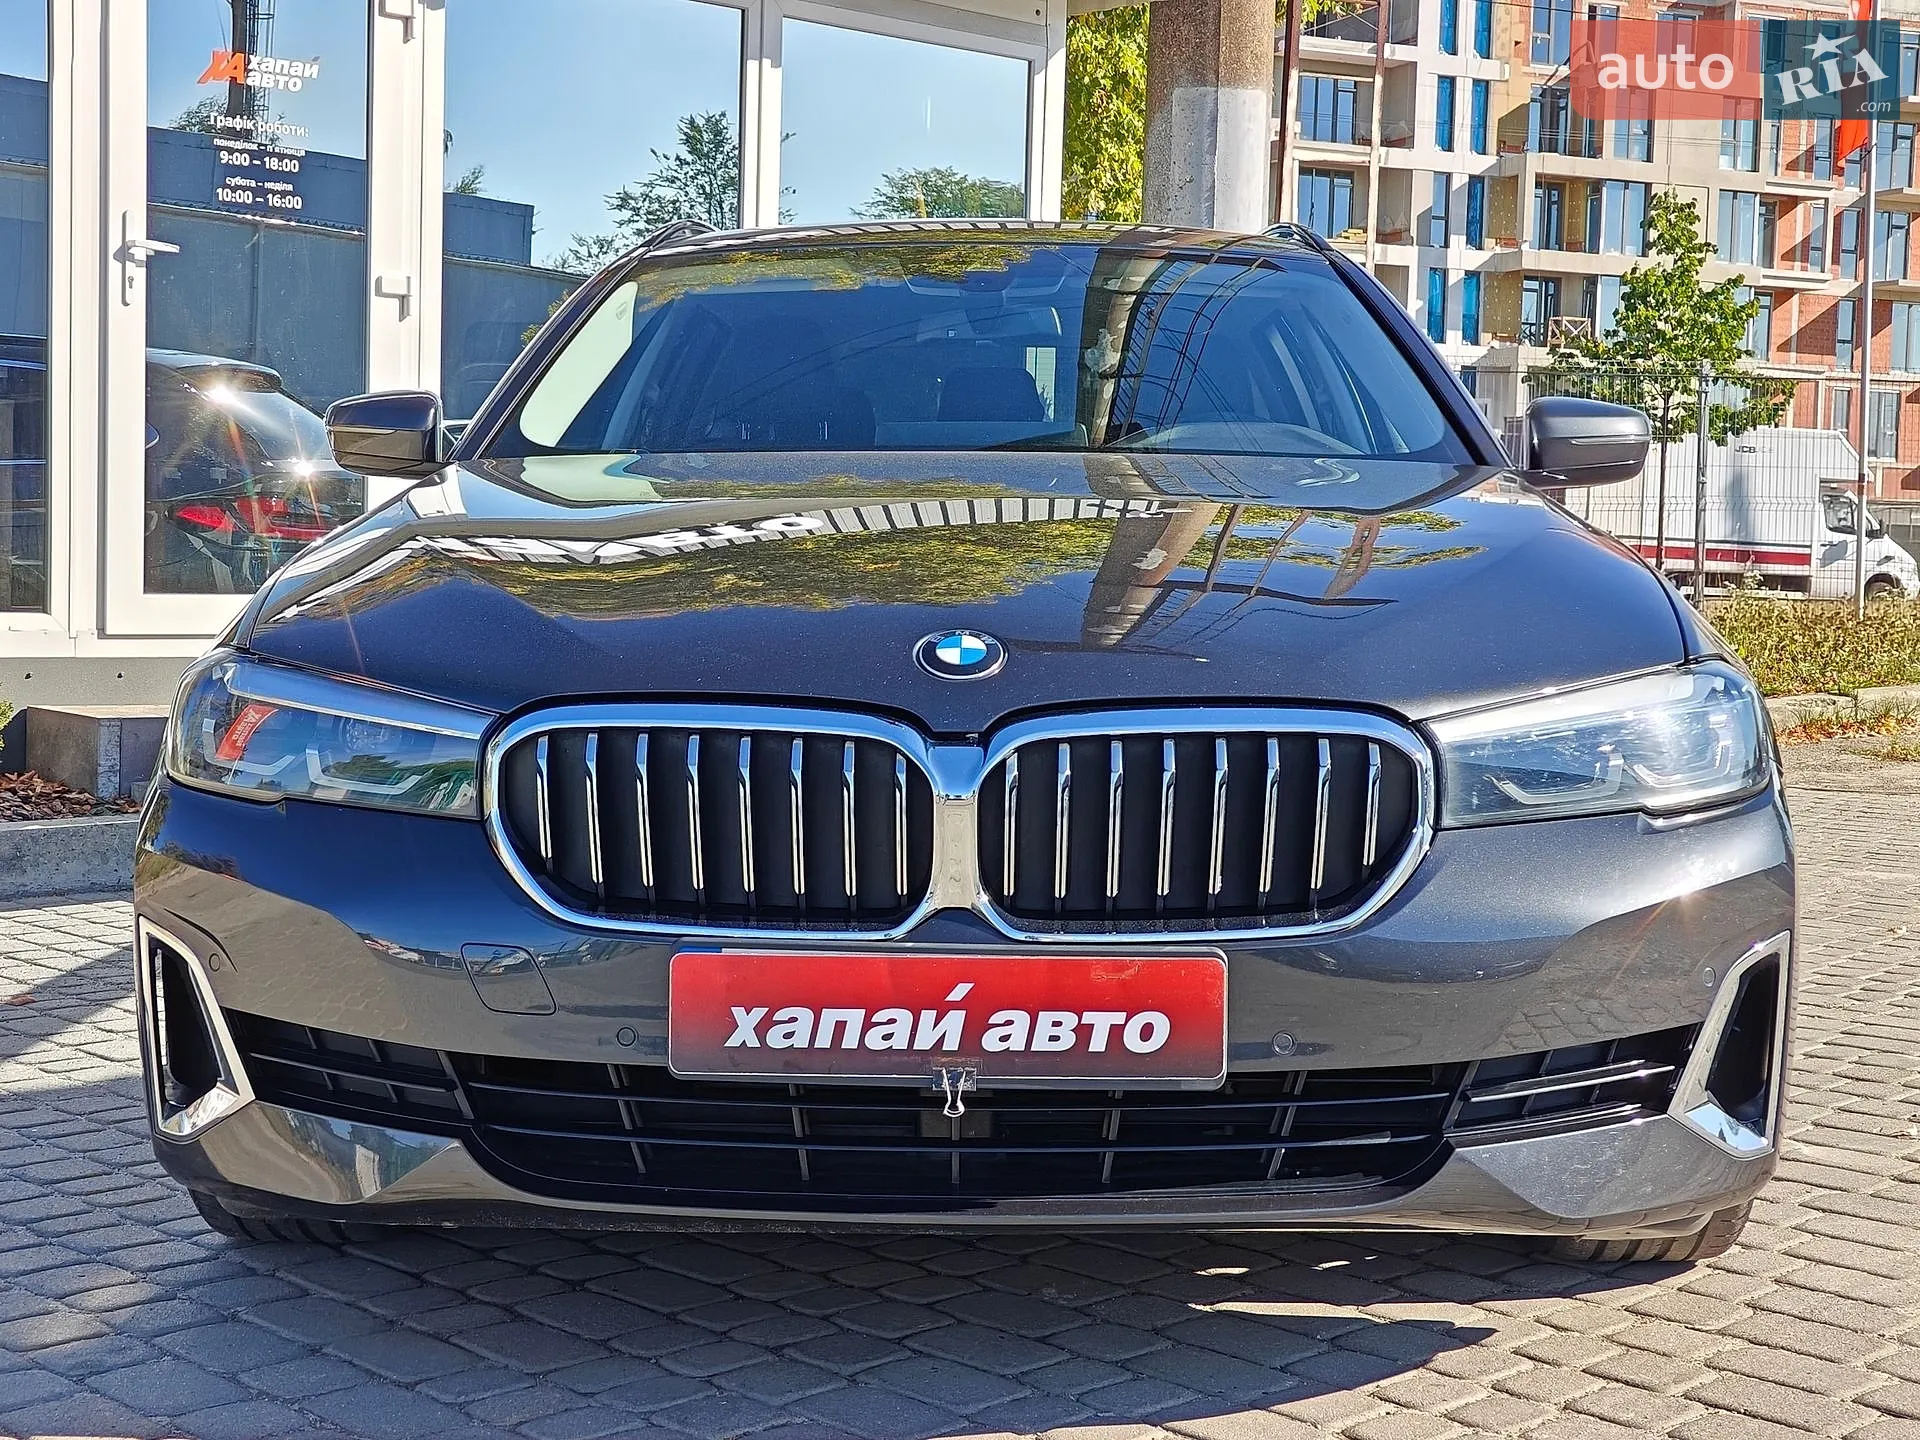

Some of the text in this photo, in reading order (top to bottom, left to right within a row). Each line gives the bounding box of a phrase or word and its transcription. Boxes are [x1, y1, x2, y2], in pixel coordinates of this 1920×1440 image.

[247, 54, 321, 79] хапай
[246, 72, 303, 93] авто
[209, 113, 309, 137] Графік роботи:
[219, 151, 250, 166] 9:00
[264, 156, 300, 173] 18:00
[225, 176, 256, 188] субота
[264, 181, 294, 193] неділя
[215, 188, 253, 204] 10:00
[266, 193, 303, 210] 16:00
[981, 1009, 1172, 1055] авто
